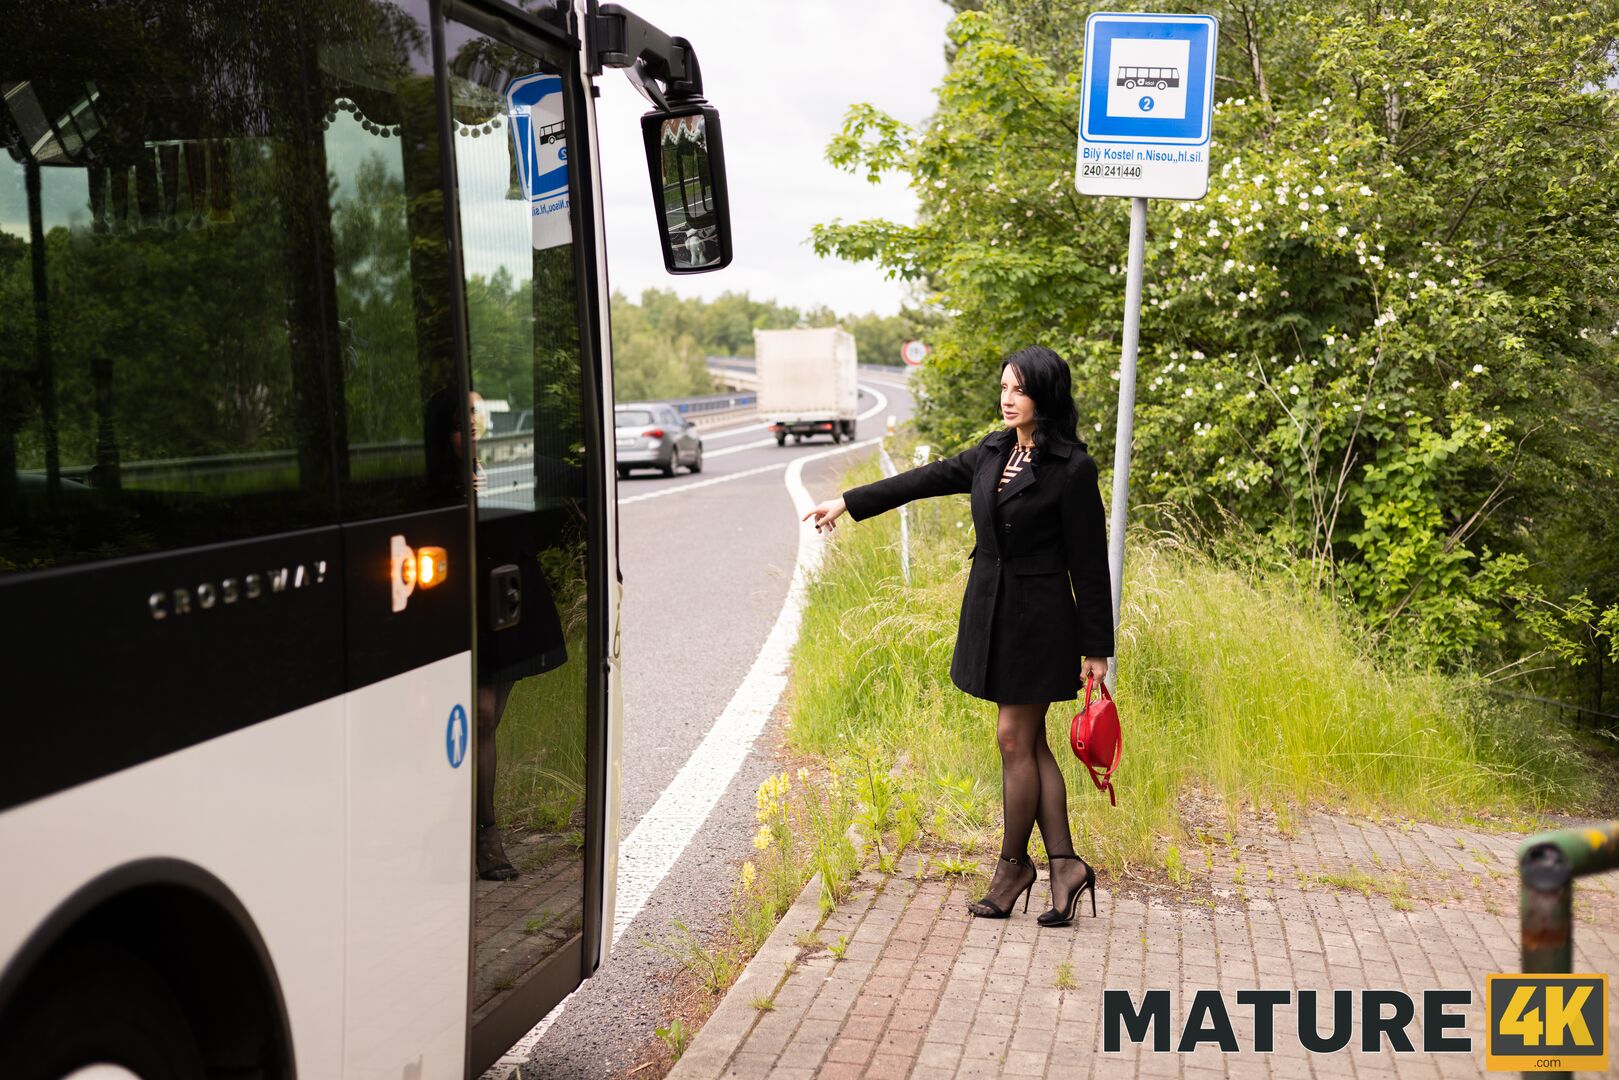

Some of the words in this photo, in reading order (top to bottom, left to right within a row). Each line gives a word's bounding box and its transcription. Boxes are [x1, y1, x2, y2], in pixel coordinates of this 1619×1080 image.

[1143, 98, 1151, 110] 2
[1104, 148, 1134, 160] Kostel
[1083, 164, 1101, 176] 240
[1104, 165, 1121, 176] 241
[1123, 166, 1141, 178] 440
[148, 560, 327, 620] CROSSWAY
